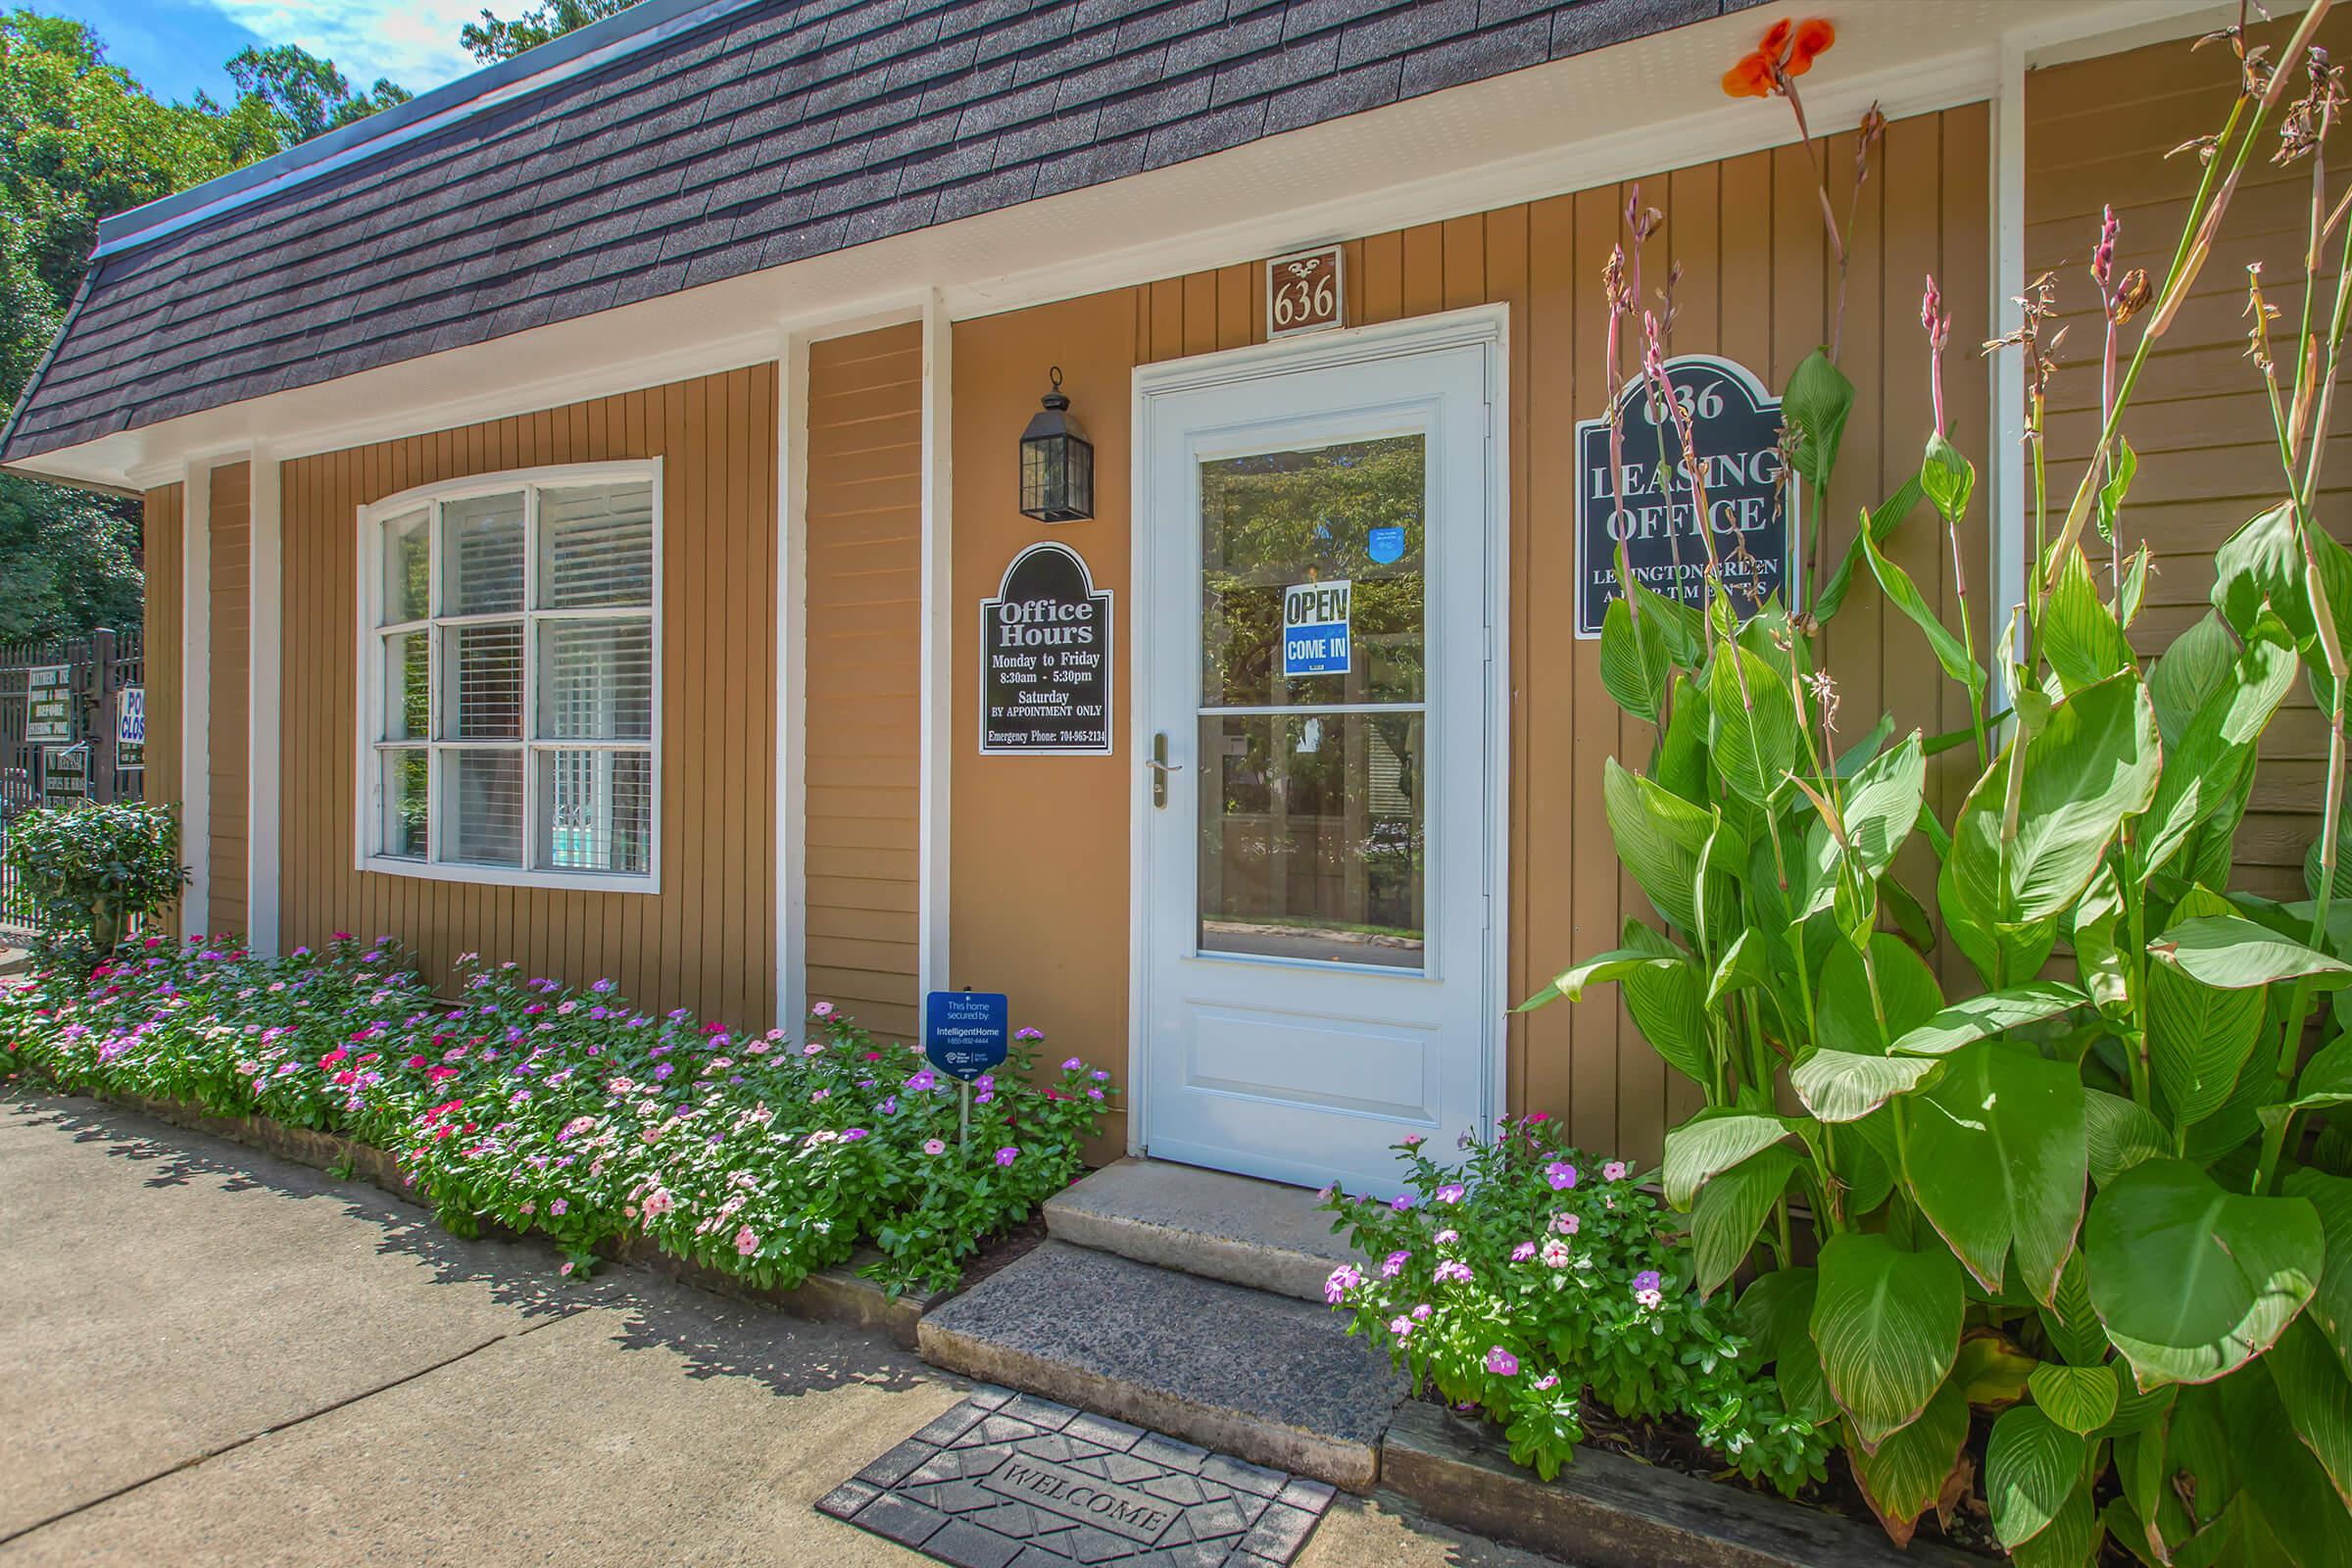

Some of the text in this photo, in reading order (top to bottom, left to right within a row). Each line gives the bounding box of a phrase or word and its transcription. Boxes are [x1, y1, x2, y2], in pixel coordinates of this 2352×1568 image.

[1275, 274, 1333, 325] 636
[1643, 379, 1725, 425] 636
[1592, 450, 1784, 499] LEASING
[1606, 497, 1767, 541] OFFICE
[1592, 564, 1703, 585] LEINGTON
[999, 599, 1094, 624] Office
[1286, 588, 1348, 625] OPEN
[999, 624, 1094, 647] Hours
[992, 651, 1100, 670] Monday to Friday
[1287, 637, 1347, 661] COME IN
[1000, 671, 1037, 684] 8:30am
[1053, 670, 1093, 685] 5:30pm
[128, 692, 145, 715] PO
[1018, 690, 1069, 707] Saturday
[991, 705, 1102, 717] BY APPOINTMENT ONLY
[988, 730, 1028, 744] Emergency
[1031, 729, 1057, 742] Phone:
[947, 1011, 978, 1020] secured
[948, 1001, 990, 1010] This home
[936, 1027, 1000, 1037] IntelligentHome
[1004, 1463, 1168, 1531] WELCOME
